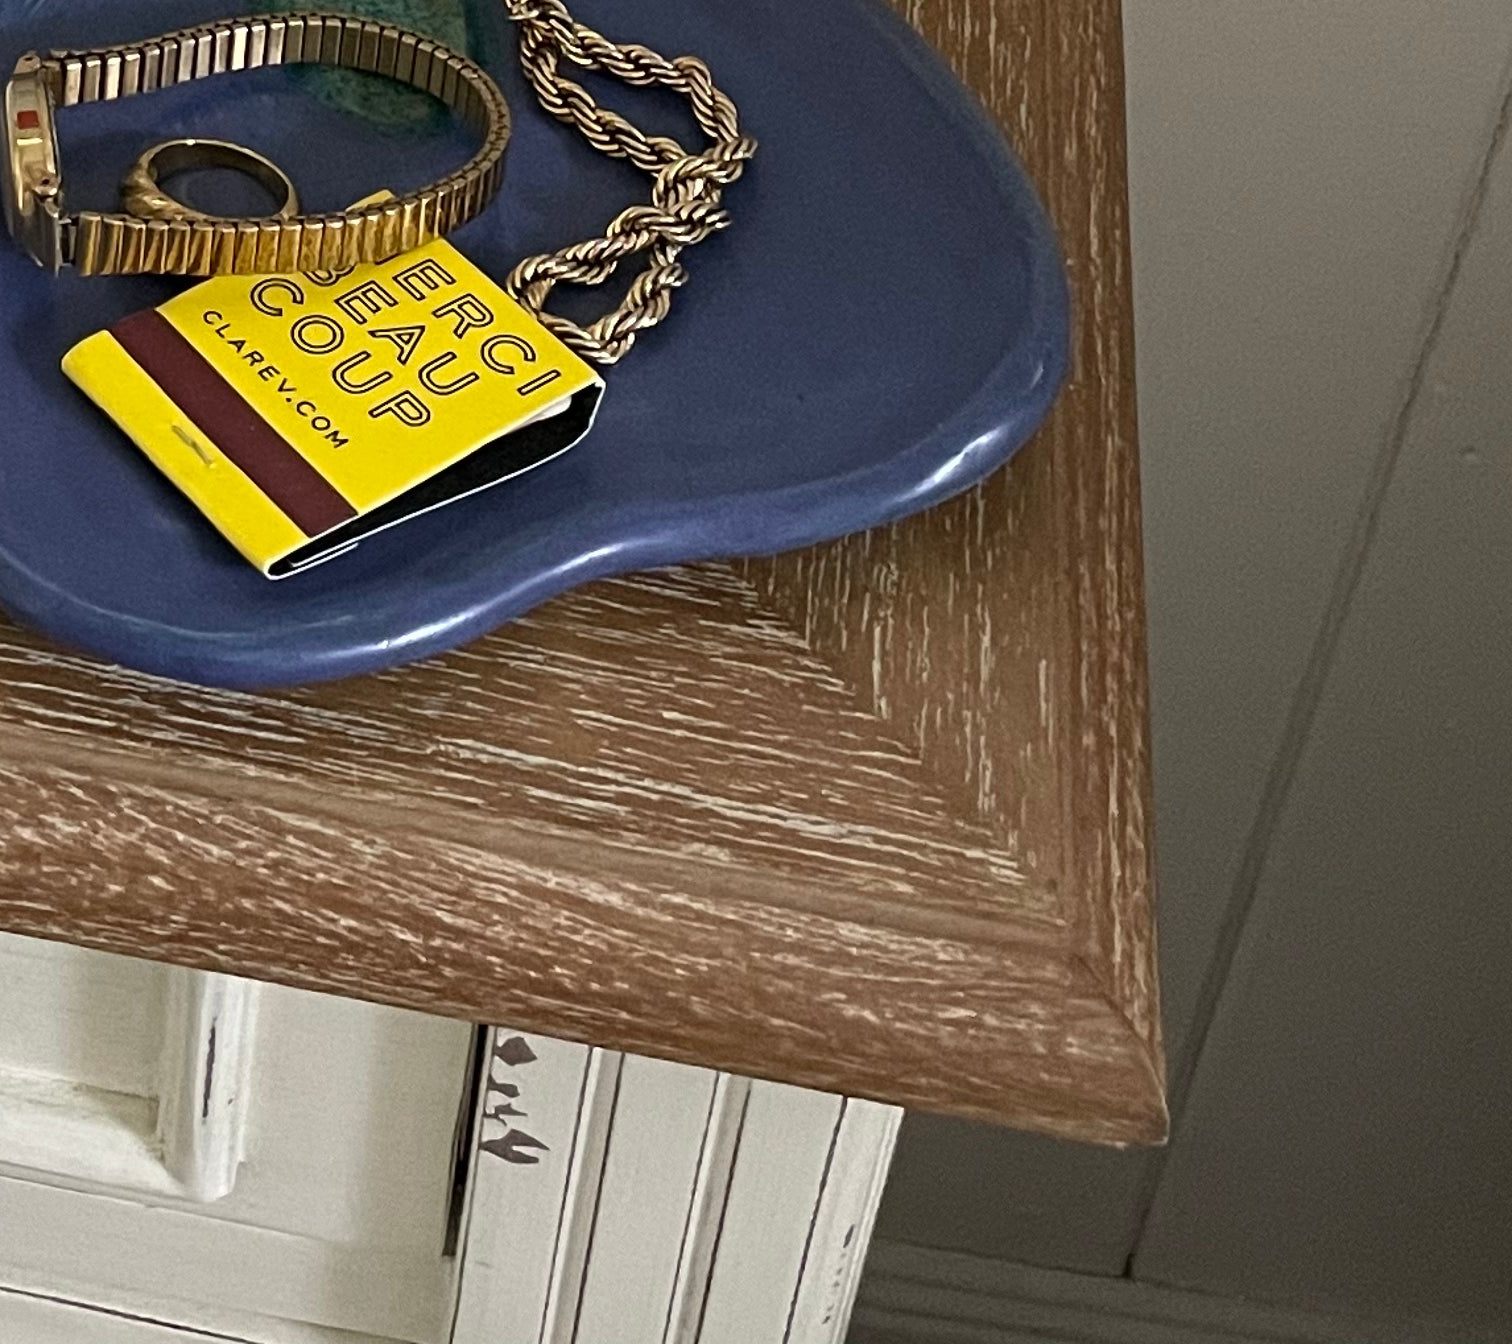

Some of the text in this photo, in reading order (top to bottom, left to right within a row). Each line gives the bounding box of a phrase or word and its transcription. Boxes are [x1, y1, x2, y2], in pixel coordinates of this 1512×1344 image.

[202, 310, 349, 449] CLAREV.COM
[250, 277, 431, 427] COUP
[375, 253, 561, 396] ERCI
